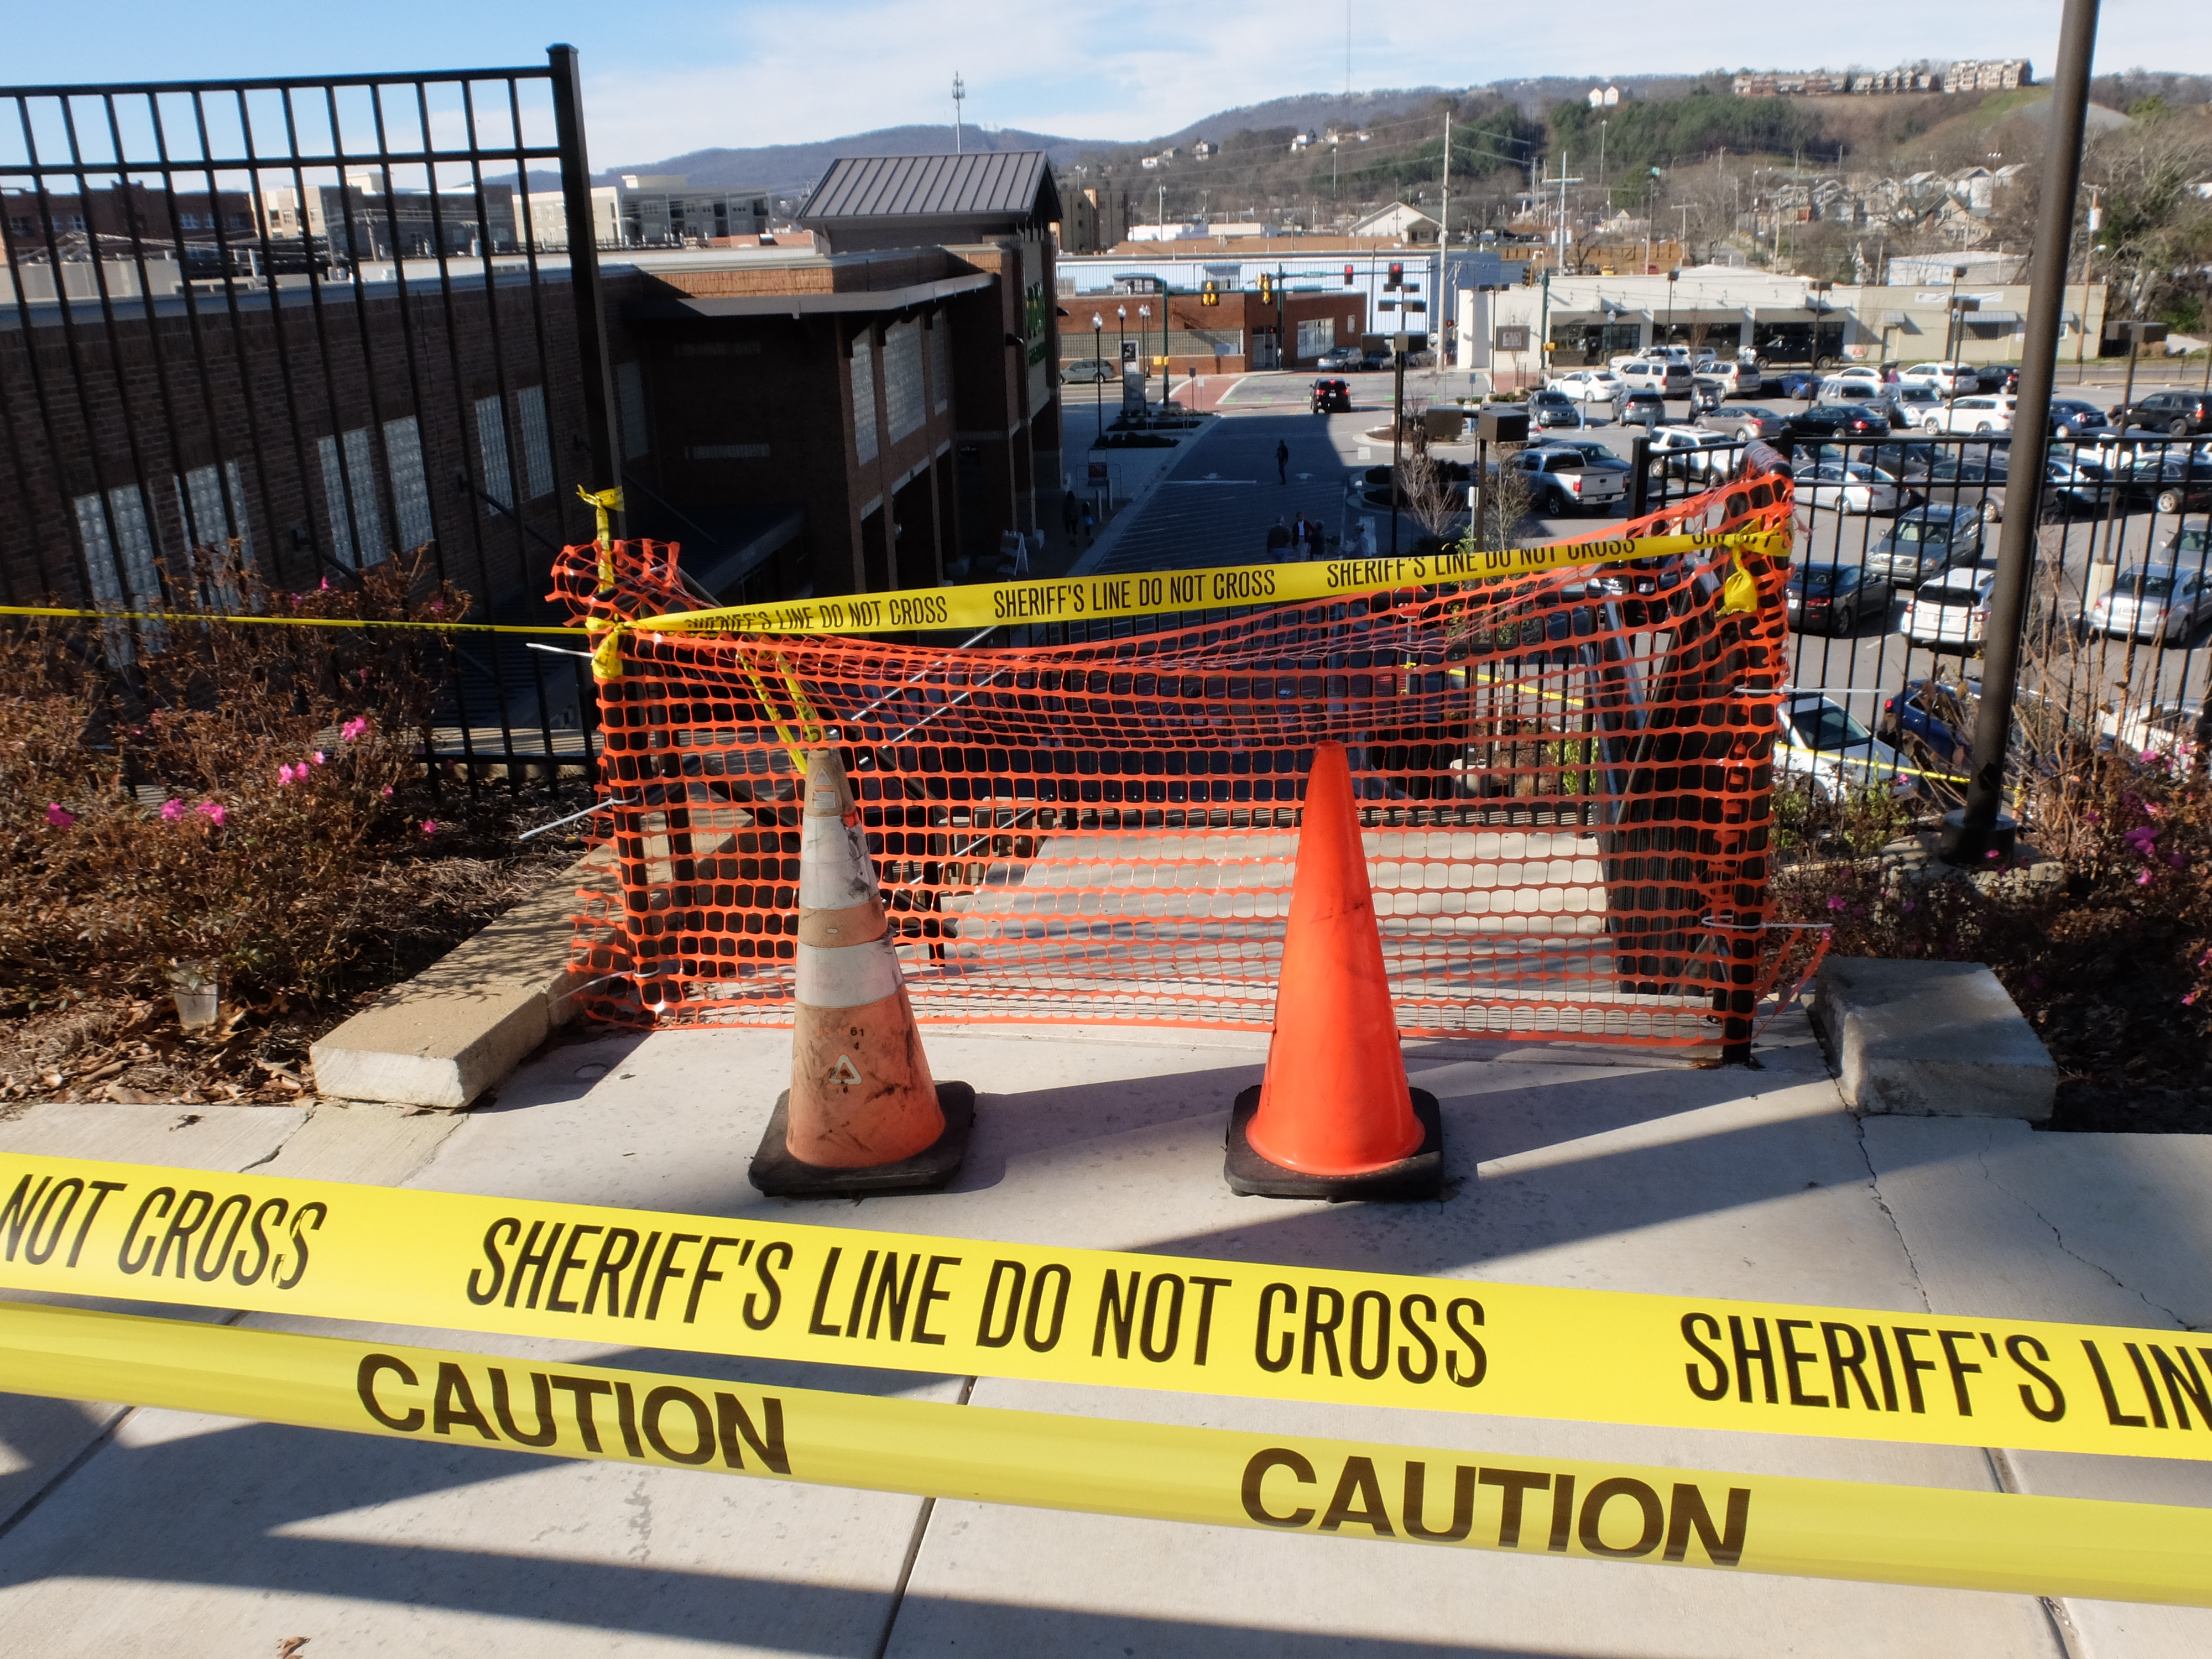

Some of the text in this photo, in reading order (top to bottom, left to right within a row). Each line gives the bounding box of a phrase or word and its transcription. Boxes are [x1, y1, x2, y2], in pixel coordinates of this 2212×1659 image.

[776, 607, 815, 629] LINE
[819, 604, 844, 628] DO
[848, 601, 881, 627] NOT
[889, 596, 948, 625] CROSS
[993, 570, 1276, 618] SHERIFF'S LINE DO NOT CROSS
[1327, 557, 1426, 588] SHERIFF'S
[1435, 554, 1478, 576] LINE
[1485, 550, 1512, 569] DO
[1520, 546, 1555, 566] NOT
[0, 1173, 328, 1290] NOT CROSS
[466, 1217, 1488, 1388] SHERIFF'S LINE DO NOT CROSS
[357, 1353, 792, 1475] CAUTION
[1679, 1312, 2212, 1431] SHERIFF'S LIN
[1240, 1447, 1751, 1567] CAUTION
